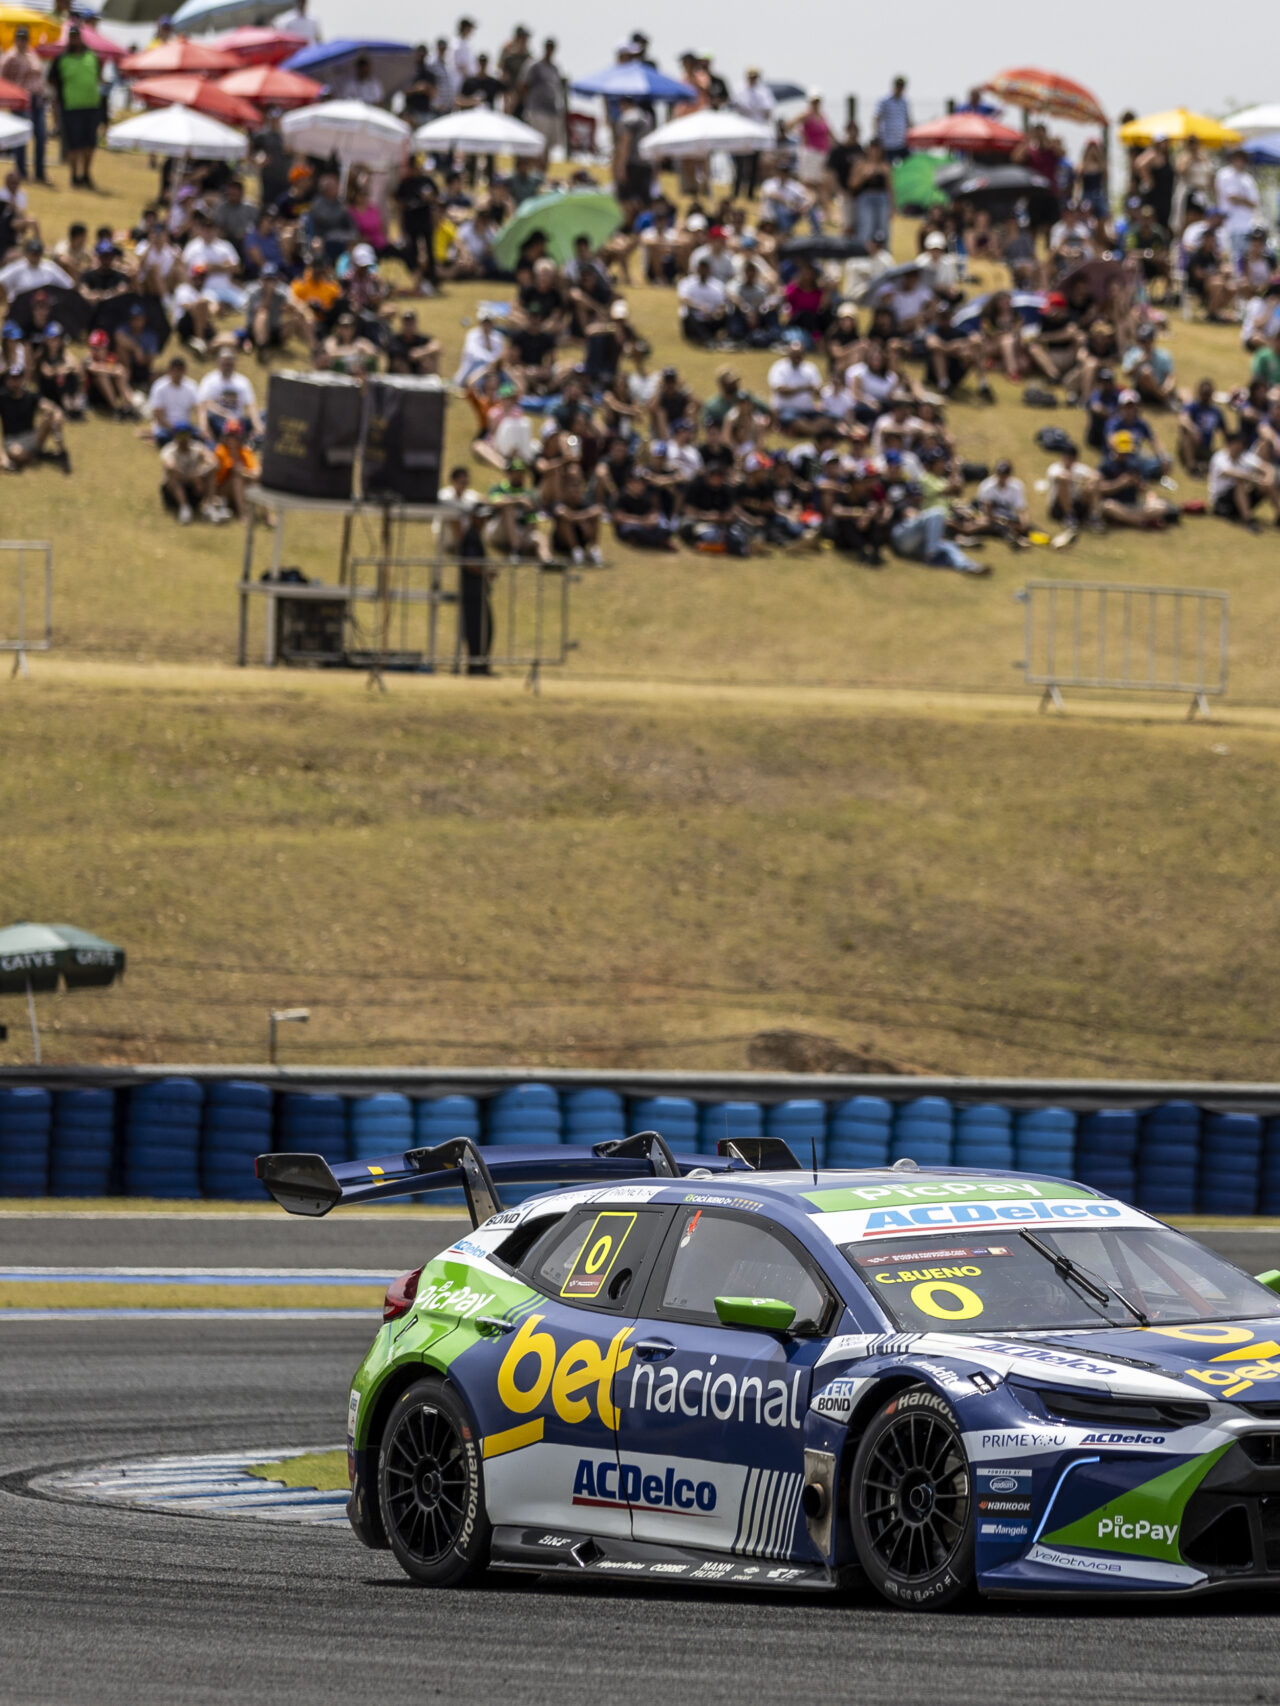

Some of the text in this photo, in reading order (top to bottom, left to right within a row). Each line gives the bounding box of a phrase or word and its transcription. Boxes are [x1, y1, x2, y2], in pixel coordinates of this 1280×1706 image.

[852, 1179, 1042, 1201] PicPay
[866, 1201, 1121, 1229] ACDelco
[585, 1235, 612, 1274] 0
[875, 1265, 982, 1284] C.BUENO
[415, 1281, 496, 1319] PicPay
[910, 1281, 984, 1320] 0
[971, 1343, 1117, 1375] ACDelco
[497, 1314, 802, 1431] bet nacional
[823, 1382, 852, 1396] TEK
[818, 1397, 850, 1412] BOND
[1081, 1433, 1165, 1444] ACDelco
[573, 1459, 717, 1511] ACDelco
[994, 1524, 1027, 1536] Mangels
[1098, 1515, 1178, 1545] PicPay
[689, 1570, 725, 1578] FILTER
[700, 1561, 735, 1571] MANN
